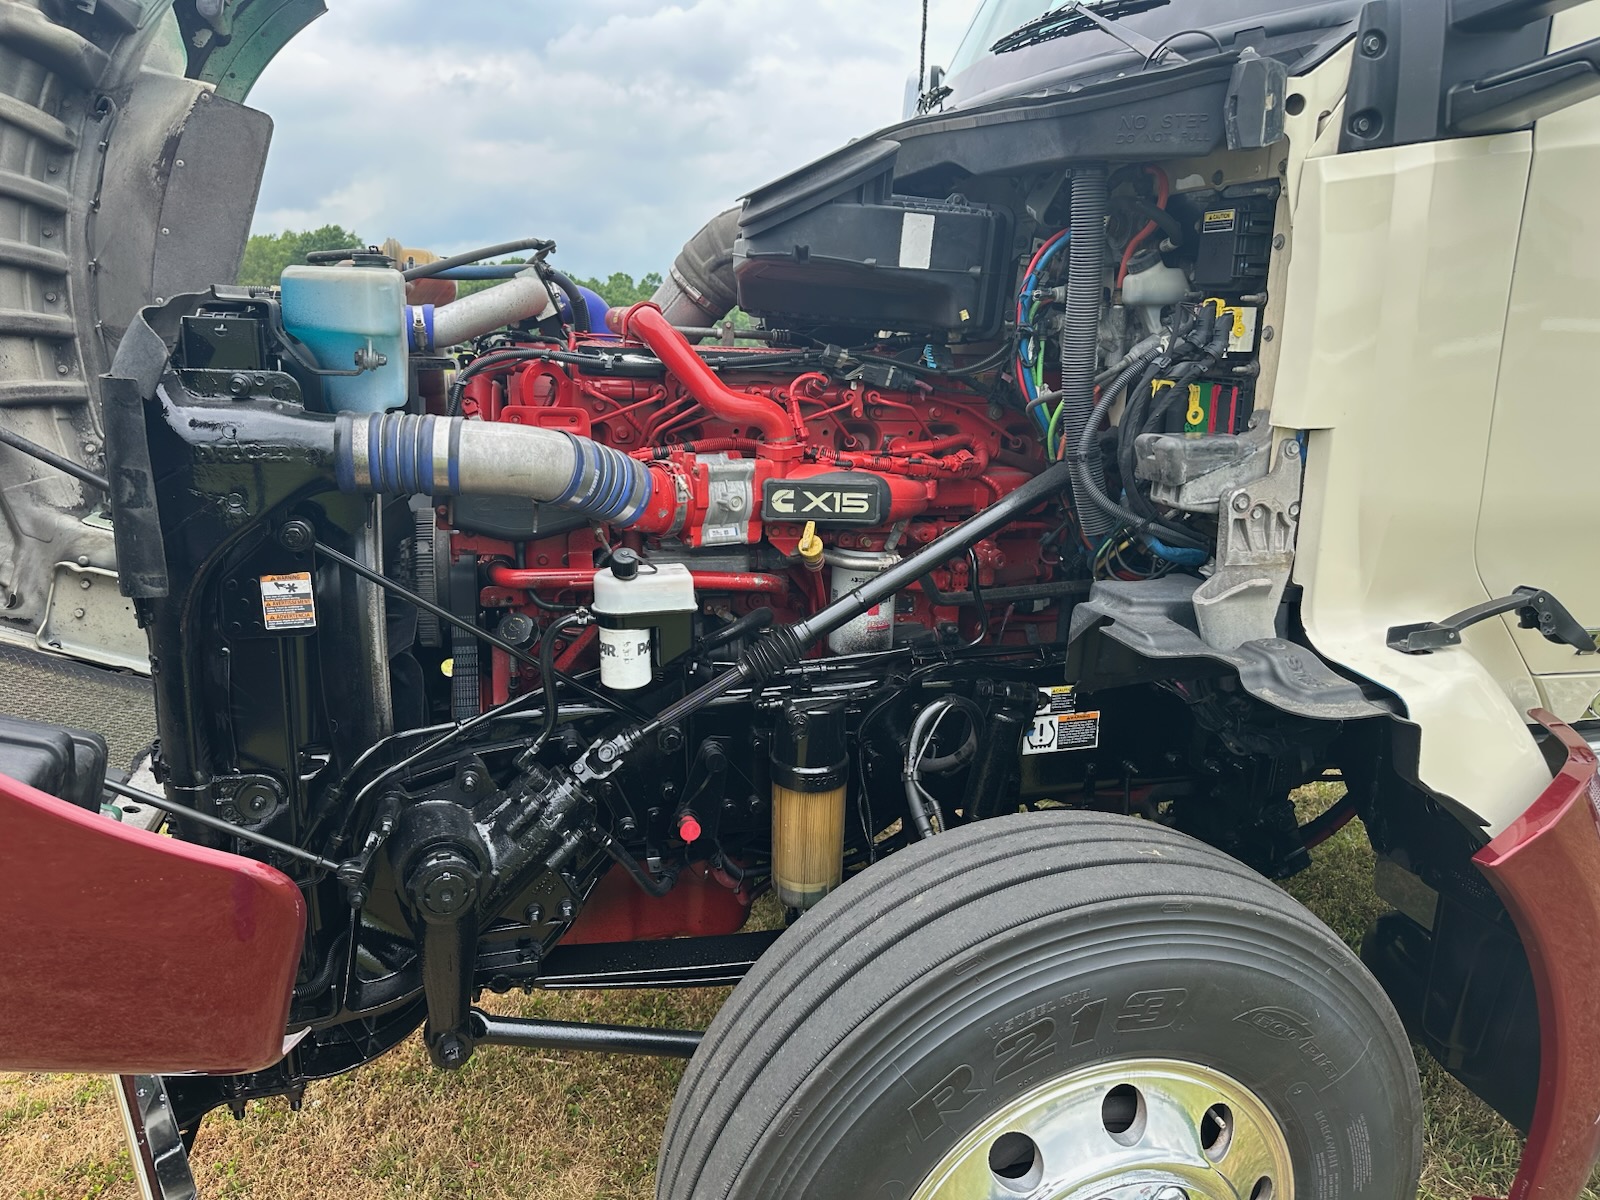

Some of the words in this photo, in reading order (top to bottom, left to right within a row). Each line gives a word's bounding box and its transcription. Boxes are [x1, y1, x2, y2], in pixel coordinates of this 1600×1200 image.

[1119, 114, 1148, 130] NO
[1160, 112, 1209, 129] STEP
[1115, 133, 1136, 144] DO
[800, 491, 870, 513] X15
